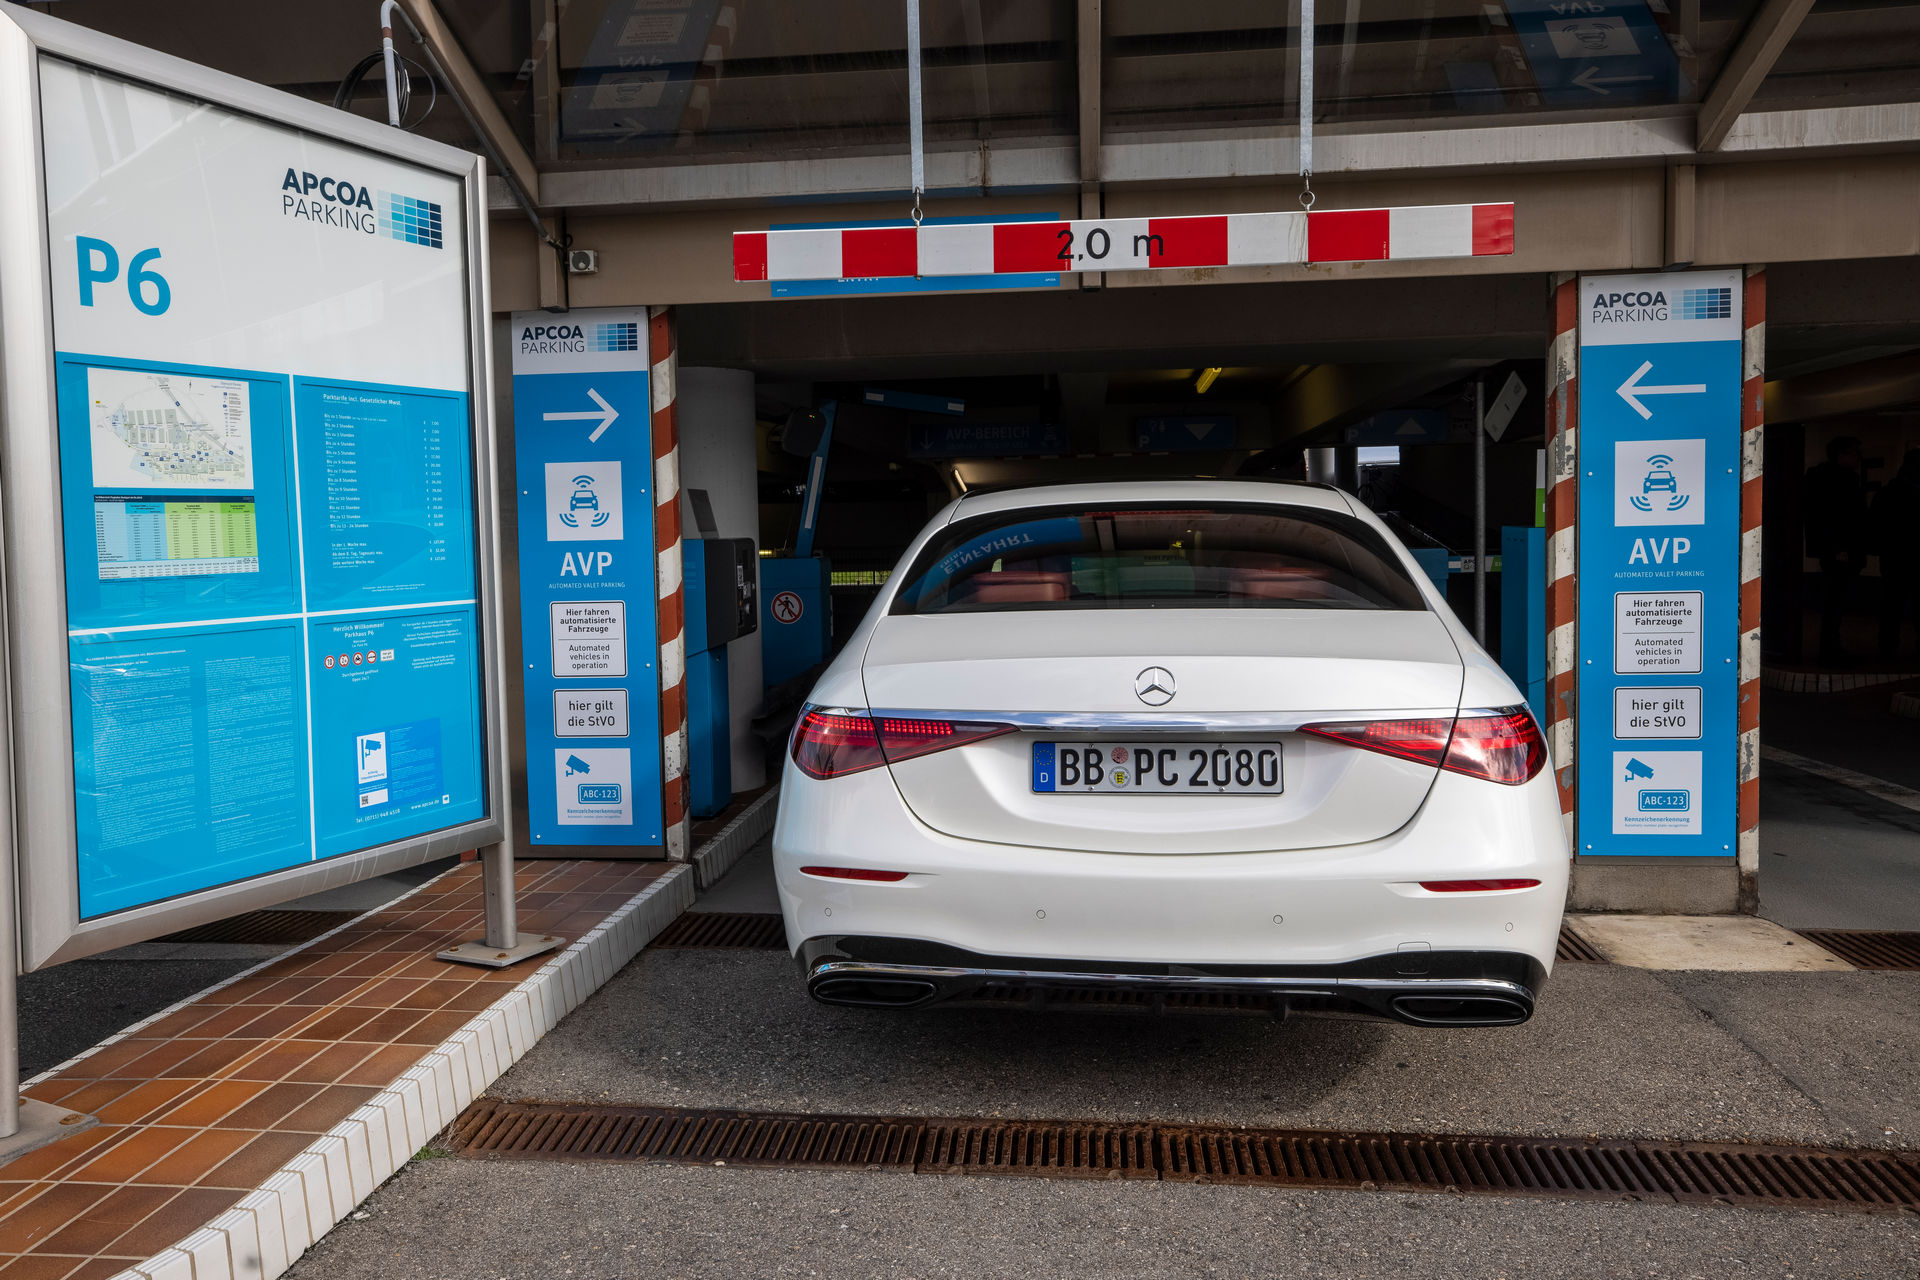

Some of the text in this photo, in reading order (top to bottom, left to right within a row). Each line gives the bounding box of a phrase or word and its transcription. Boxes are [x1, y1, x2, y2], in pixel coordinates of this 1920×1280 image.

[281, 167, 374, 211] APCOA
[282, 194, 376, 235] PARKING
[1056, 228, 1164, 262] 2,0 m
[75, 235, 172, 317] P6
[1592, 291, 1667, 308] APCOA
[1592, 308, 1668, 323] PARKING
[521, 325, 584, 340] APCOA
[521, 340, 585, 354] PARKING
[360, 396, 388, 404] Gesetzlicher
[946, 426, 1030, 440] AVP-BEREICH
[1628, 537, 1691, 564] AVP
[560, 551, 612, 576] AVP
[1626, 609, 1692, 617] automatisierte
[560, 616, 616, 625] automatisierte
[1635, 618, 1683, 626] Fahrzeuge
[568, 625, 609, 633] Fahrzeuge
[1635, 638, 1683, 646] Automated
[572, 662, 608, 670] operation
[1638, 657, 1680, 666] operation
[569, 700, 613, 713] hier gilt
[1632, 699, 1684, 712] hier gilt
[568, 716, 615, 727] die StVO
[1630, 716, 1686, 727] die StVO
[1040, 772, 1048, 782] D
[1060, 749, 1104, 786] BB
[1134, 749, 1178, 786] PC
[1189, 749, 1278, 786] 2080
[583, 790, 617, 798] ABC-123
[1644, 796, 1684, 805] ABC-123
